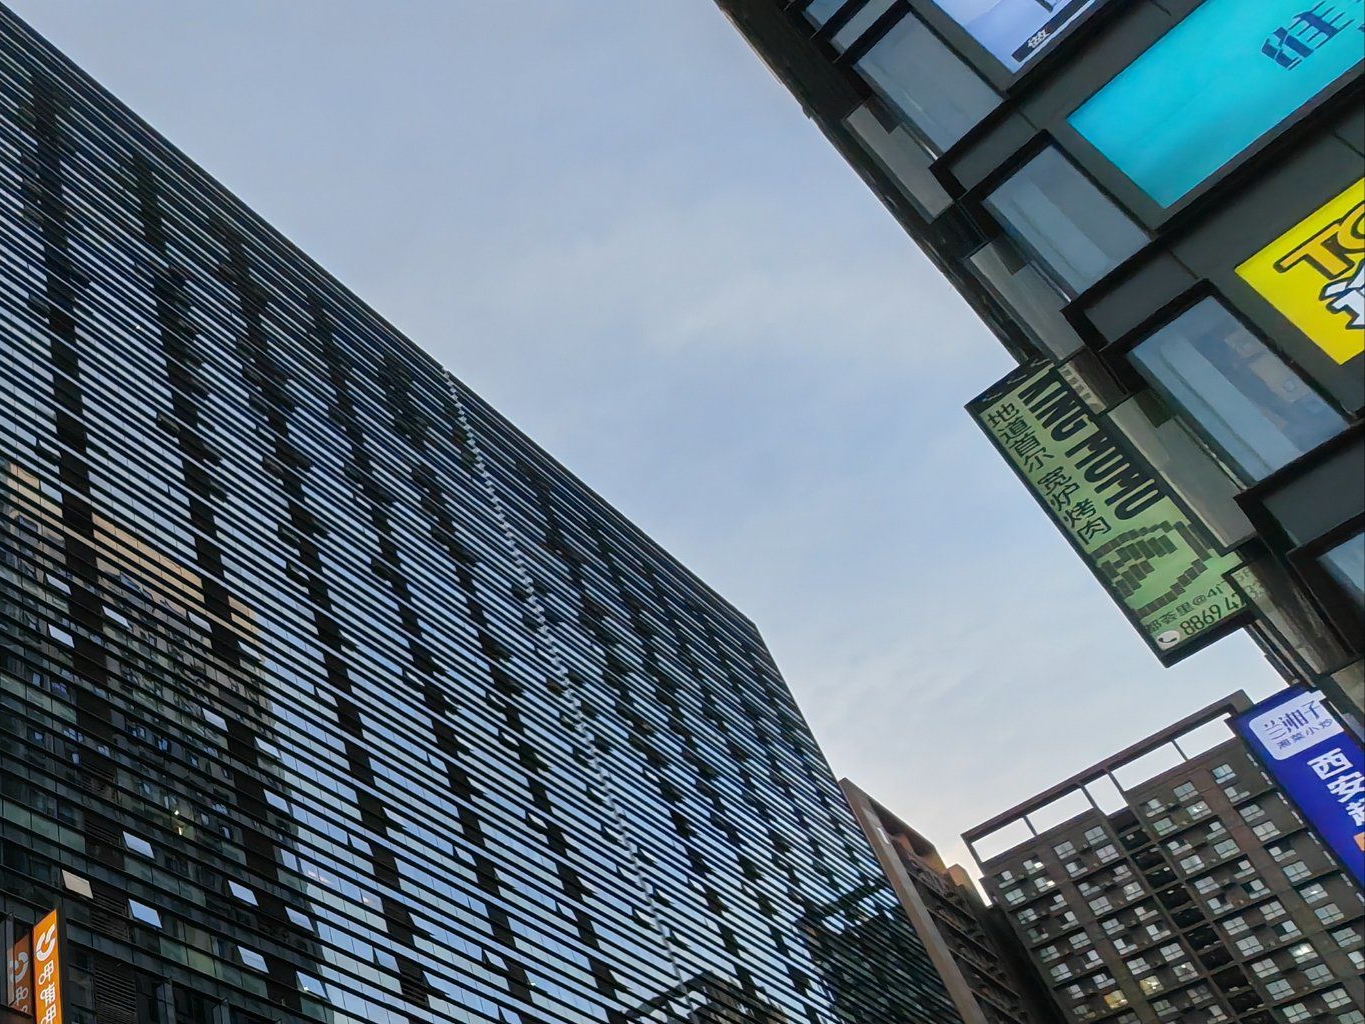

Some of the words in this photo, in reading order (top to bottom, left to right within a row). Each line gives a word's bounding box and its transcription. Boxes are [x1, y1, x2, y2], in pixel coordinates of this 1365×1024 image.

[987, 402, 1055, 473] 地道首尔
[1037, 466, 1112, 545] 宽炉烤肉
[1064, 430, 1167, 521] MUMU
[1180, 604, 1223, 637] 8869
[1263, 701, 1322, 740] 兰湘子
[1277, 718, 1334, 750] 湘菜小炒
